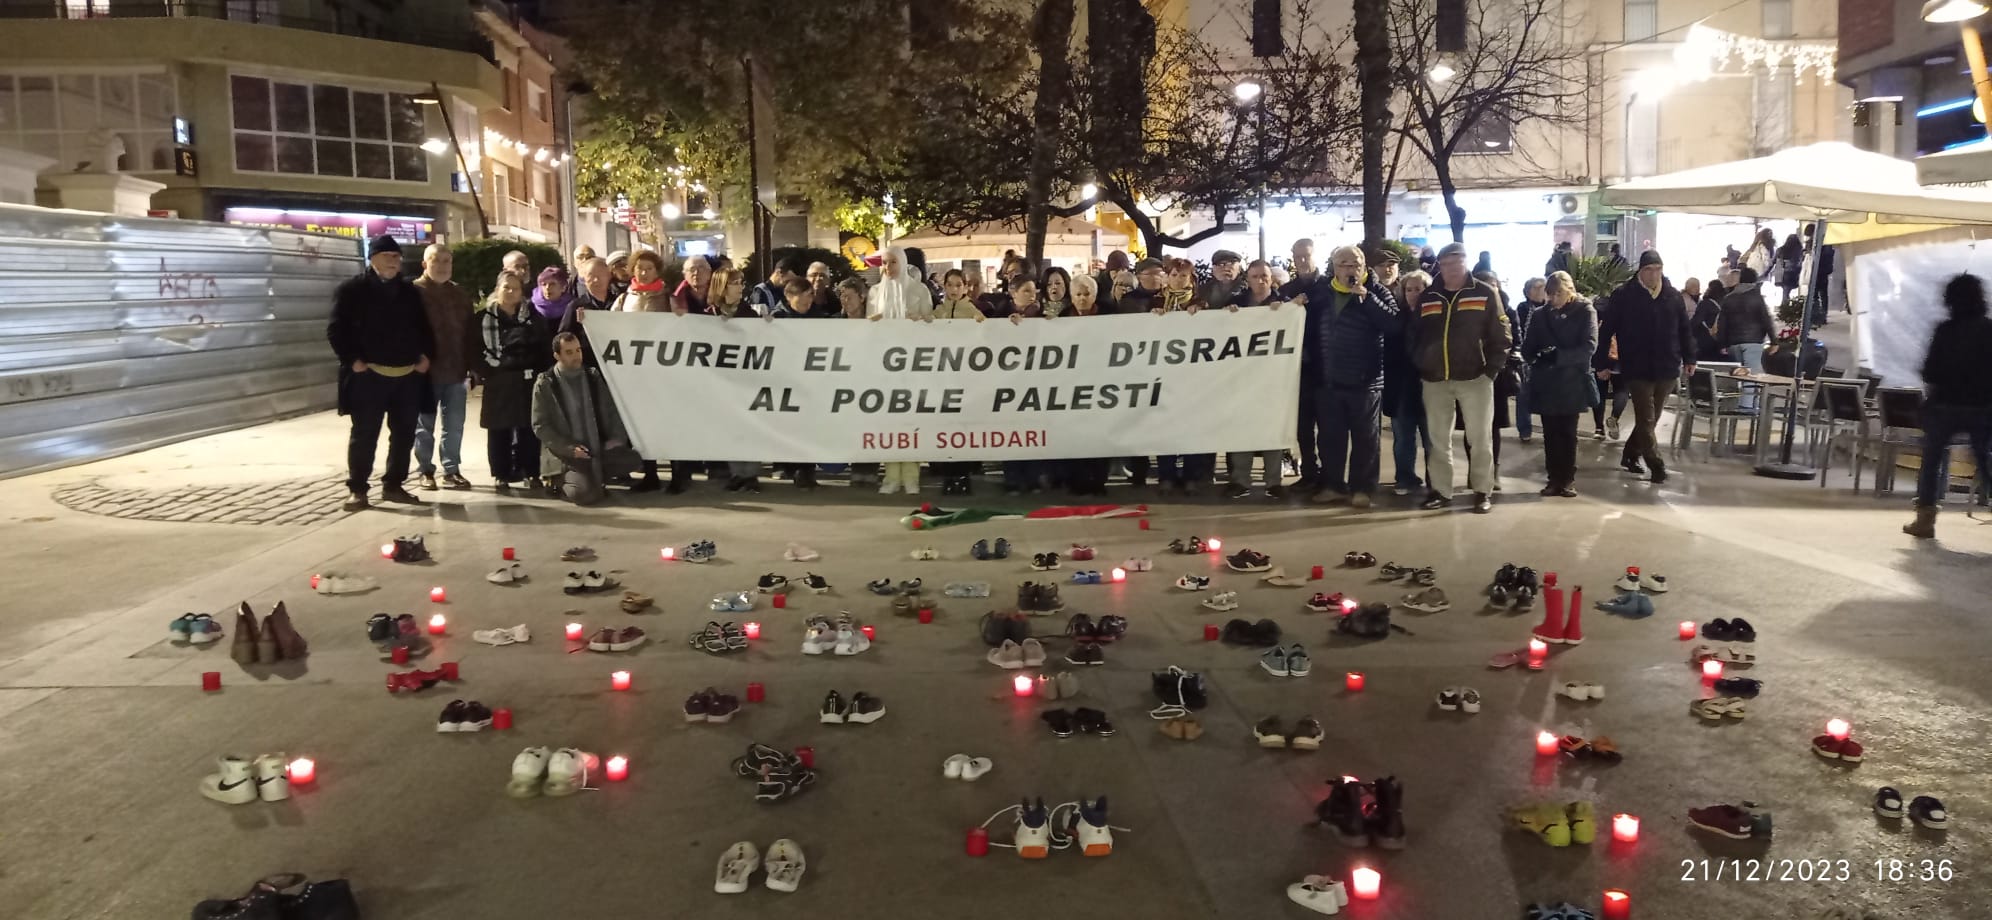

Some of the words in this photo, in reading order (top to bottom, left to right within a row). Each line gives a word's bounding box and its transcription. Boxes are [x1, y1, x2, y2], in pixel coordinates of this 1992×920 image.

[602, 339, 776, 371] ATUREM
[804, 346, 852, 372] EL
[882, 344, 1080, 373] GENOCIDI
[1108, 329, 1295, 368] D’ISRAEL
[748, 386, 800, 413] AL
[831, 388, 964, 414] POBLE
[992, 377, 1163, 413] PALESTÍ
[862, 427, 920, 450] RUBÍ
[936, 430, 1048, 449] SOLIDARI
